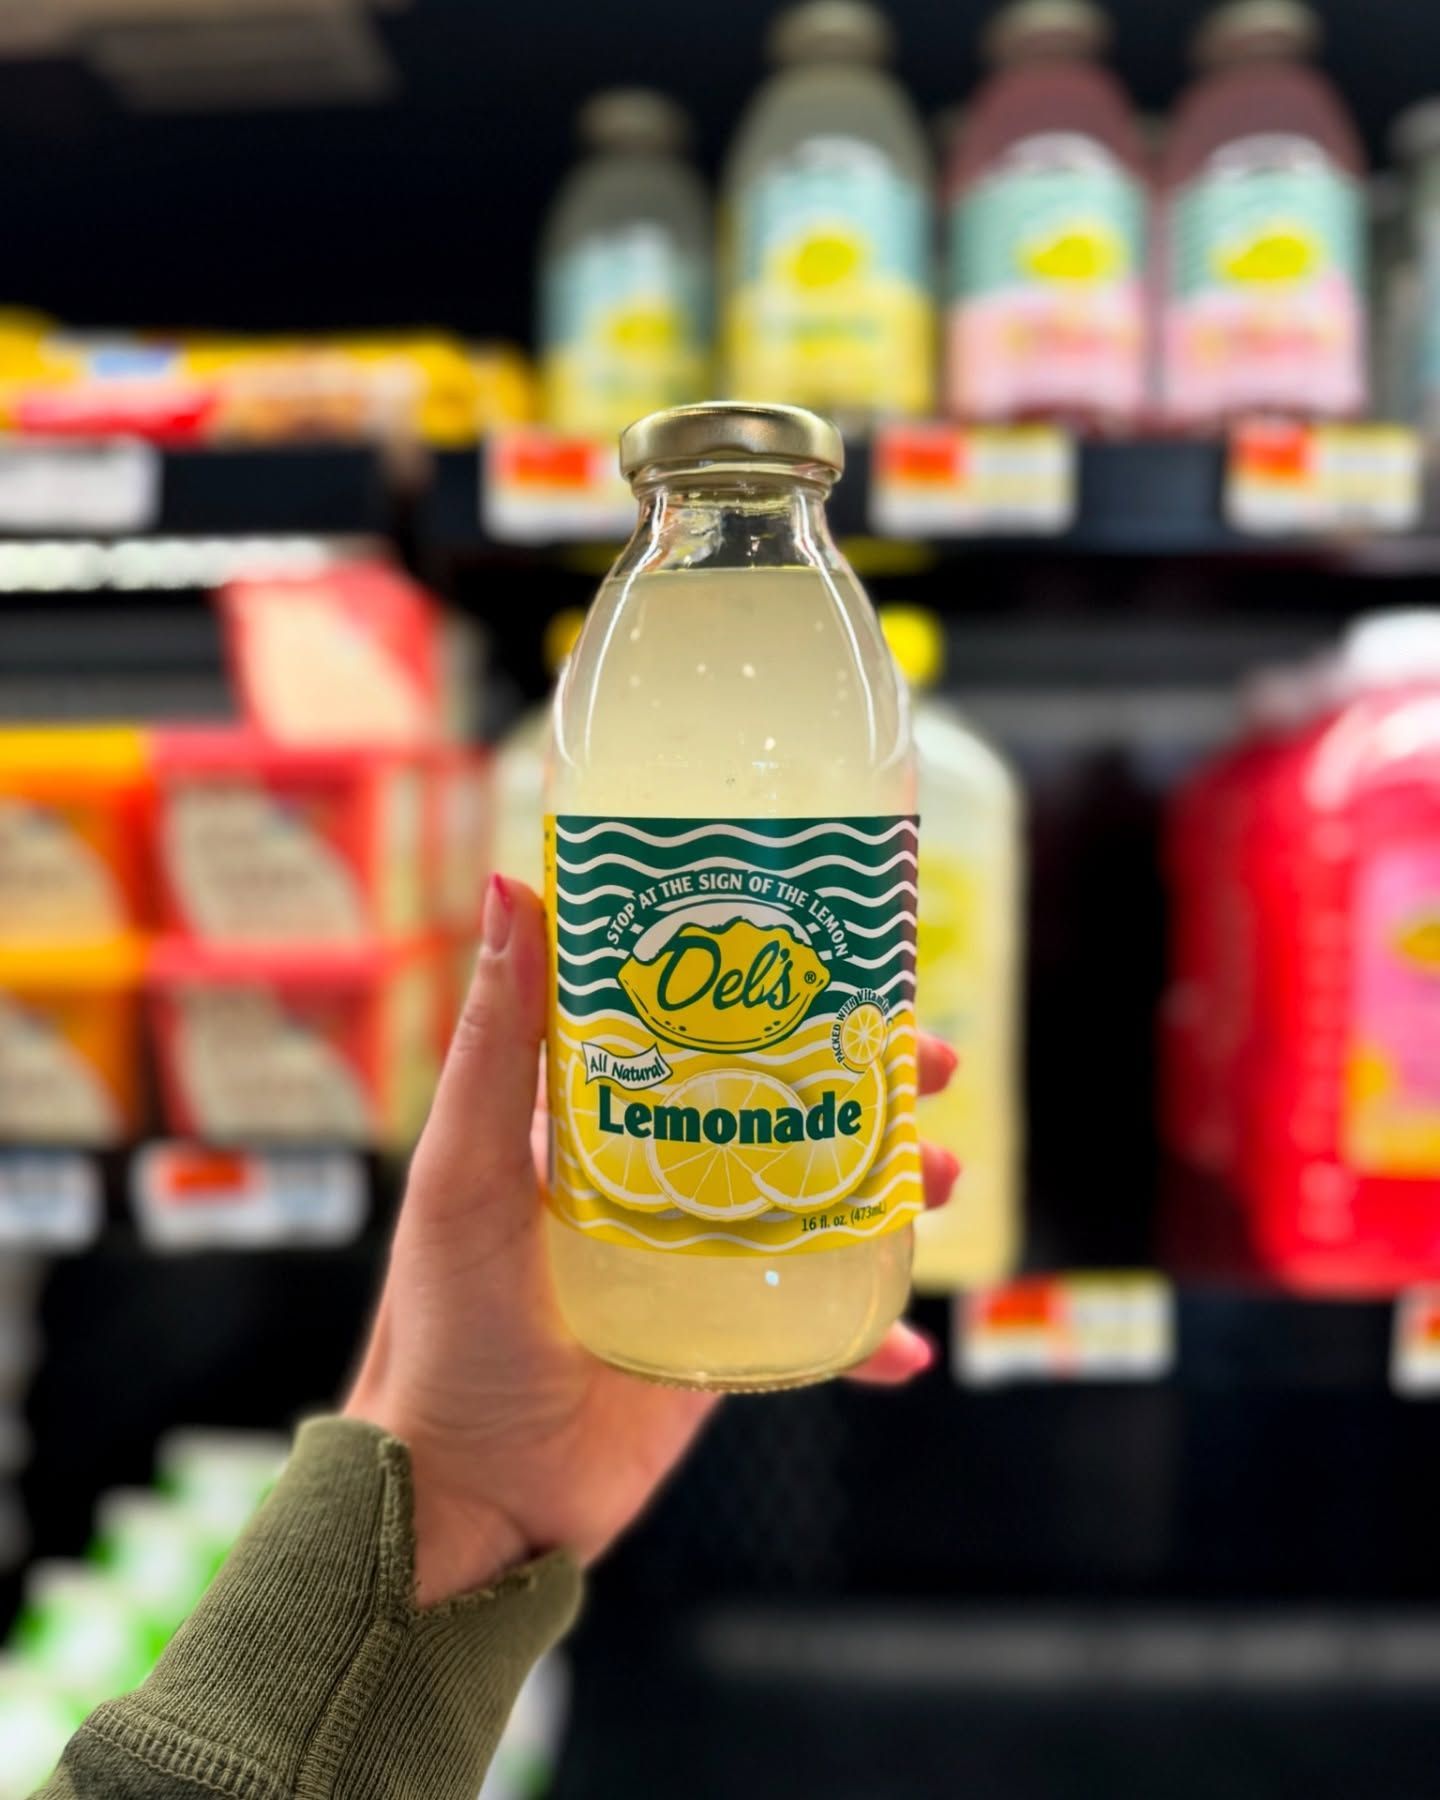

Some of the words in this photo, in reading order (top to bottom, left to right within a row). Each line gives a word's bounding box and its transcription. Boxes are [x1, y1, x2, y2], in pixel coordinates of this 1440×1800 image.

[607, 903, 636, 944] STOP
[640, 888, 657, 909] AT
[659, 876, 694, 898] THE
[699, 873, 743, 890] SIGN
[749, 876, 774, 893] OF
[777, 882, 809, 908] THE
[808, 900, 849, 958] LEMON
[657, 935, 800, 1012] Del's
[836, 995, 860, 1021] WITH
[832, 1023, 845, 1063] PACKED
[590, 1053, 608, 1073] All
[612, 1056, 666, 1082] Natural
[598, 1085, 862, 1144] Lemonade
[802, 1216, 817, 1231] 16
[820, 1214, 830, 1229] fl.
[833, 1216, 847, 1226] oz.
